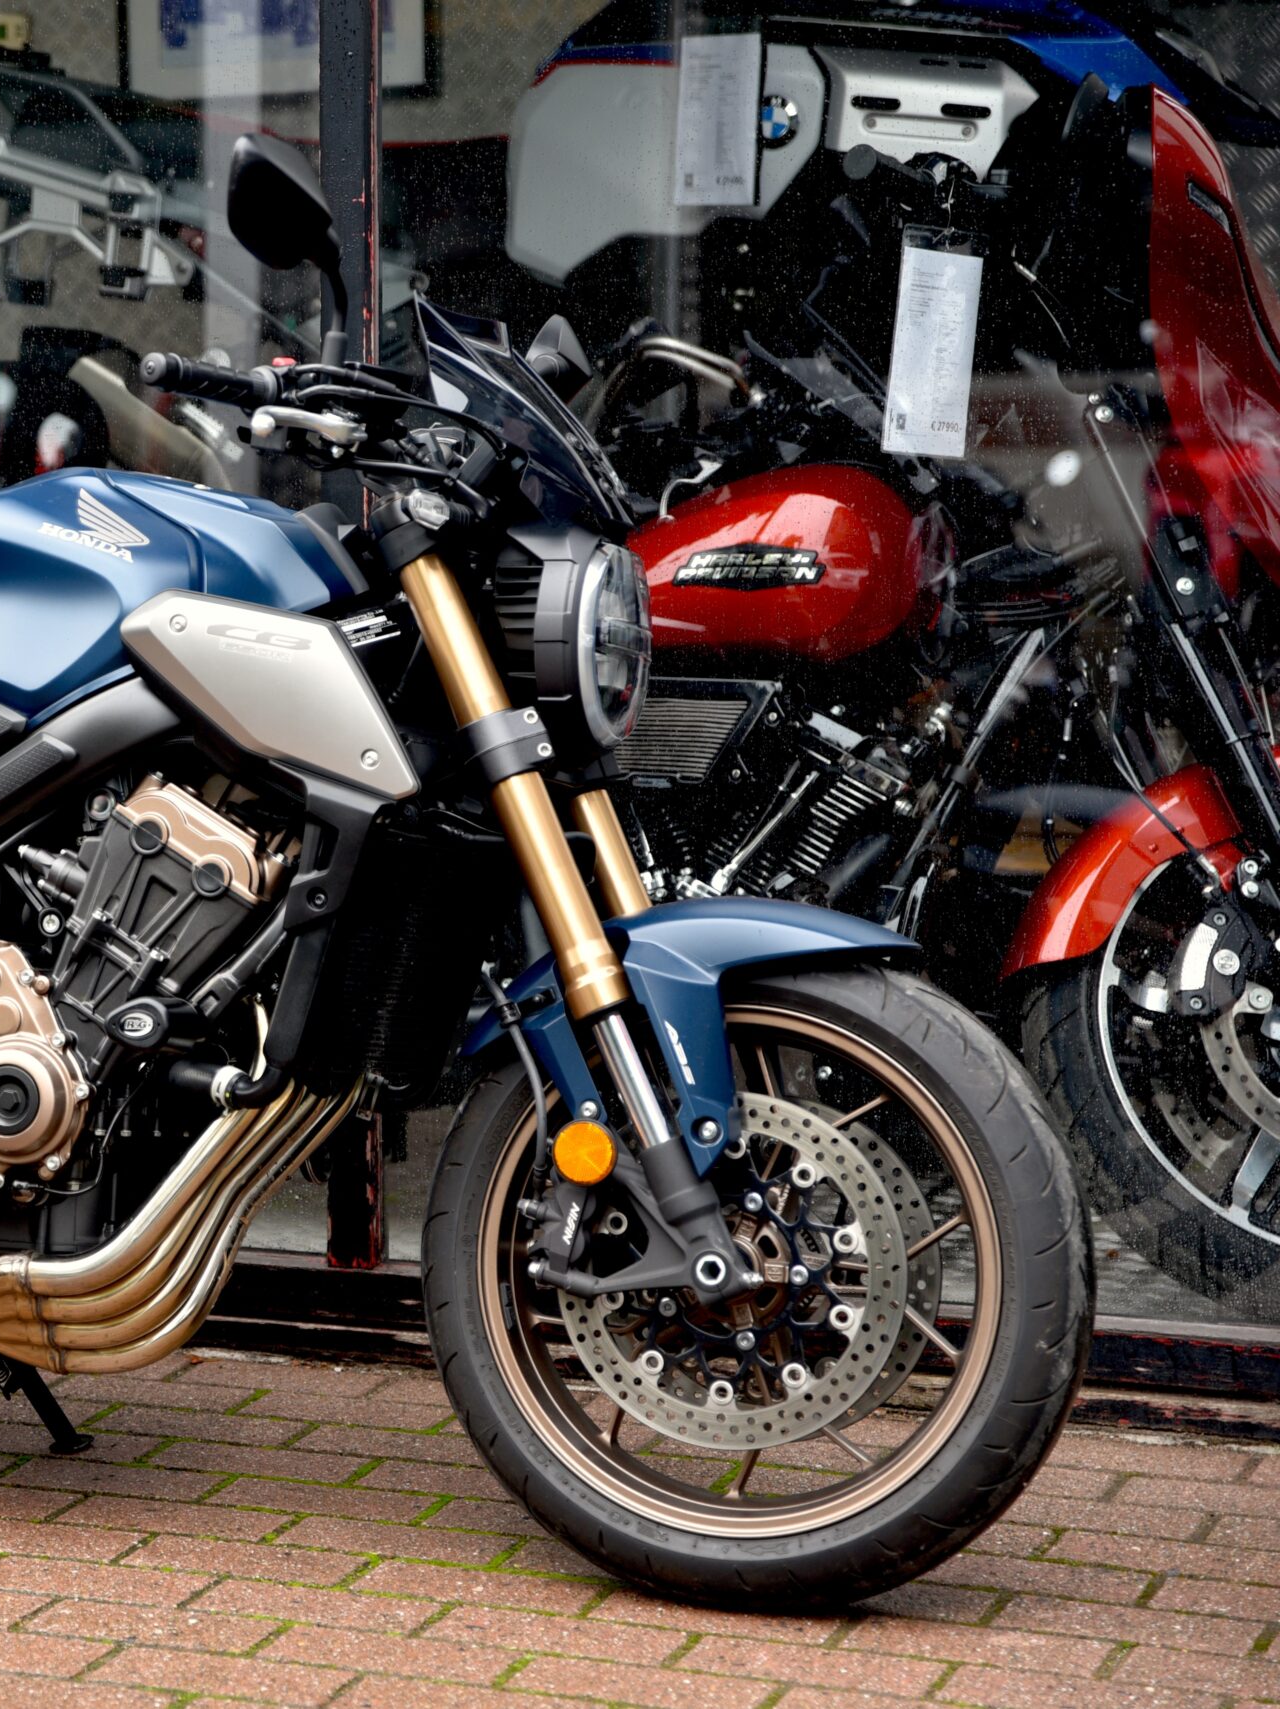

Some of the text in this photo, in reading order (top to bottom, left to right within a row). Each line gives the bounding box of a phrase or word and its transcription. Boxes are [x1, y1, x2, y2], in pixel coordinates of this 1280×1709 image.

[37, 522, 134, 564] HONDA
[677, 567, 817, 580] DAVIDSON
[205, 624, 313, 651] CB
